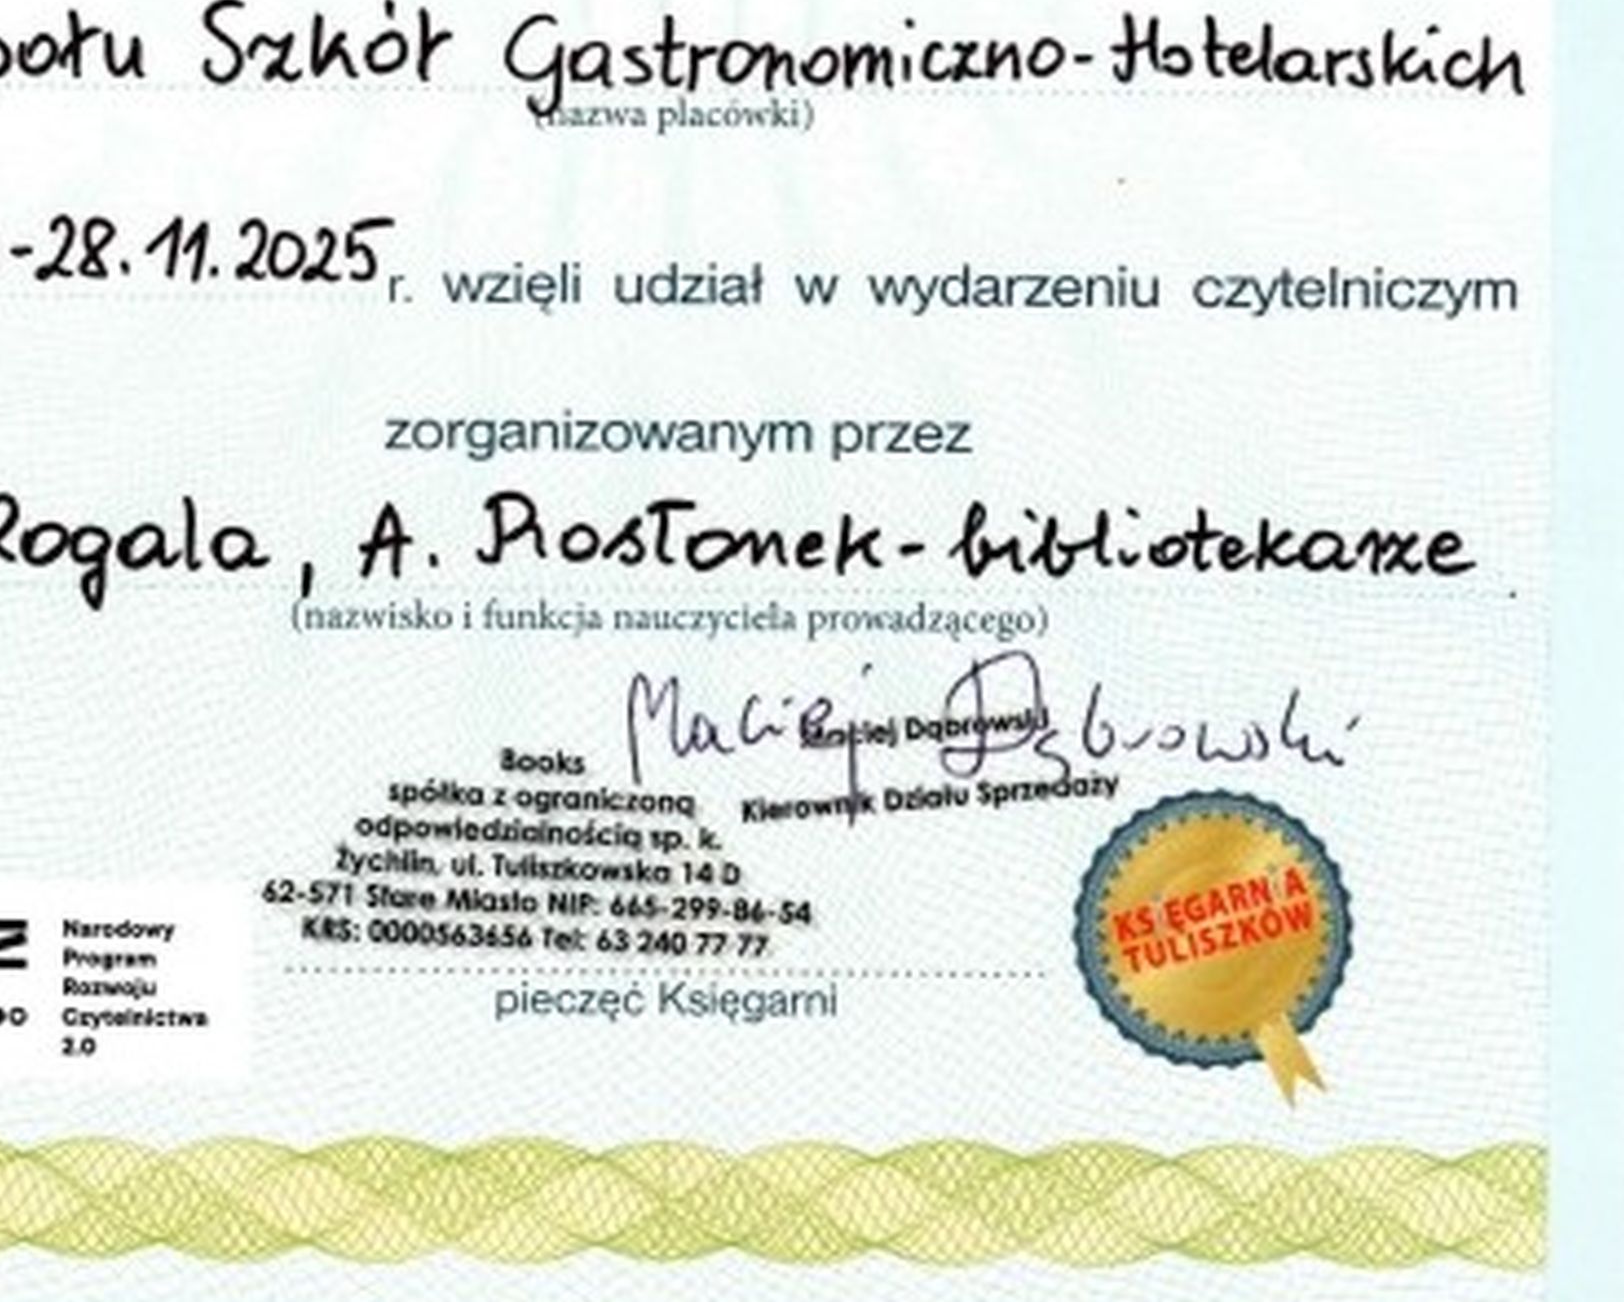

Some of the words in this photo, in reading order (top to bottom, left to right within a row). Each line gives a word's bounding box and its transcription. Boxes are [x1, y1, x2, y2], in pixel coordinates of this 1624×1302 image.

[658, 96, 815, 135] placówki)
[388, 272, 413, 303] r.
[442, 261, 581, 315] wzięli
[615, 262, 763, 307] udział
[795, 274, 839, 306] w
[867, 263, 1159, 317] wydarzeniu
[1193, 267, 1519, 317] czytelniczym
[385, 409, 813, 463] zorganizowanym
[832, 418, 975, 462] przez
[290, 600, 453, 633] (nazwisko
[484, 600, 602, 636] funkcja
[614, 602, 796, 639] nauczyciela
[808, 602, 1048, 642] prowadzącego)
[500, 747, 586, 776] Books
[388, 777, 485, 810] spółka
[516, 786, 696, 818] ograniczoną
[884, 780, 970, 815] Działu
[977, 770, 1121, 811] Sprzedaży
[354, 815, 642, 852] odpowiedzialnością
[491, 855, 673, 883] Tuliszkowska
[262, 879, 354, 908] 62-571
[367, 882, 438, 911] Stare
[445, 885, 539, 914] Miasto
[62, 918, 176, 943] Narodowy
[62, 947, 158, 973] Program
[62, 976, 158, 1001] Rozwoju
[496, 982, 643, 1022] pieczęć
[659, 980, 837, 1024] Księgarni
